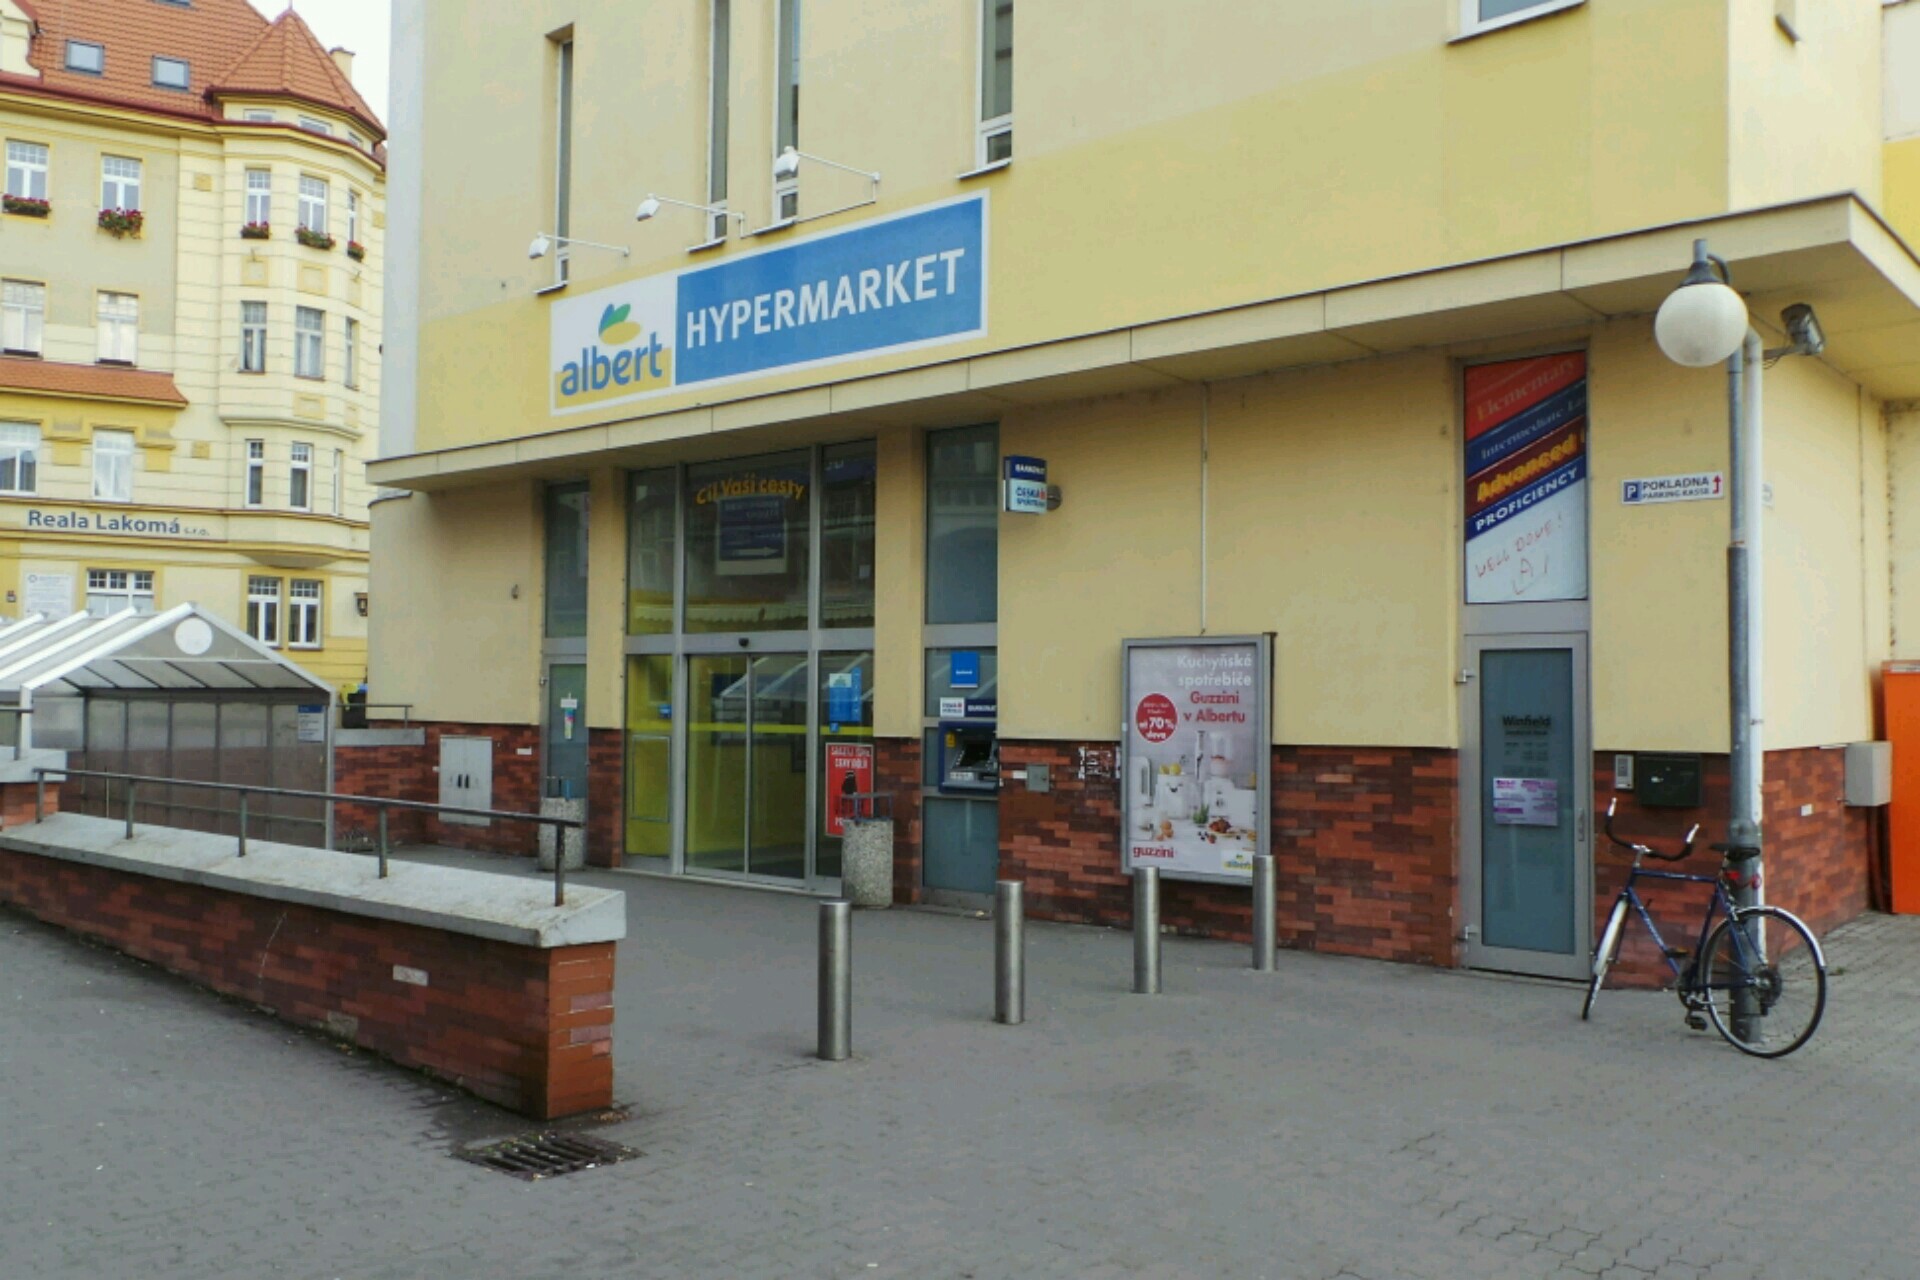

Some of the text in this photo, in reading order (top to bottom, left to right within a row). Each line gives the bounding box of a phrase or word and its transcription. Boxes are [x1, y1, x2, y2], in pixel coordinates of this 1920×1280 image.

[687, 247, 965, 349] HYPERMARKET
[561, 331, 662, 396] albert
[1477, 359, 1575, 421] Elementary
[1481, 408, 1564, 460] Intermediate
[1477, 432, 1576, 502] Advanced
[760, 479, 805, 500] cesty
[1643, 477, 1709, 490] POKLADNA
[1475, 467, 1578, 531] PROFICIENCY
[28, 510, 89, 529] Reala
[96, 513, 180, 534] Lakomá
[1178, 671, 1252, 689] spotřebiče
[1190, 690, 1239, 704] Guzzini
[1183, 708, 1245, 723] v Albertu
[1133, 846, 1174, 858] guzzini
